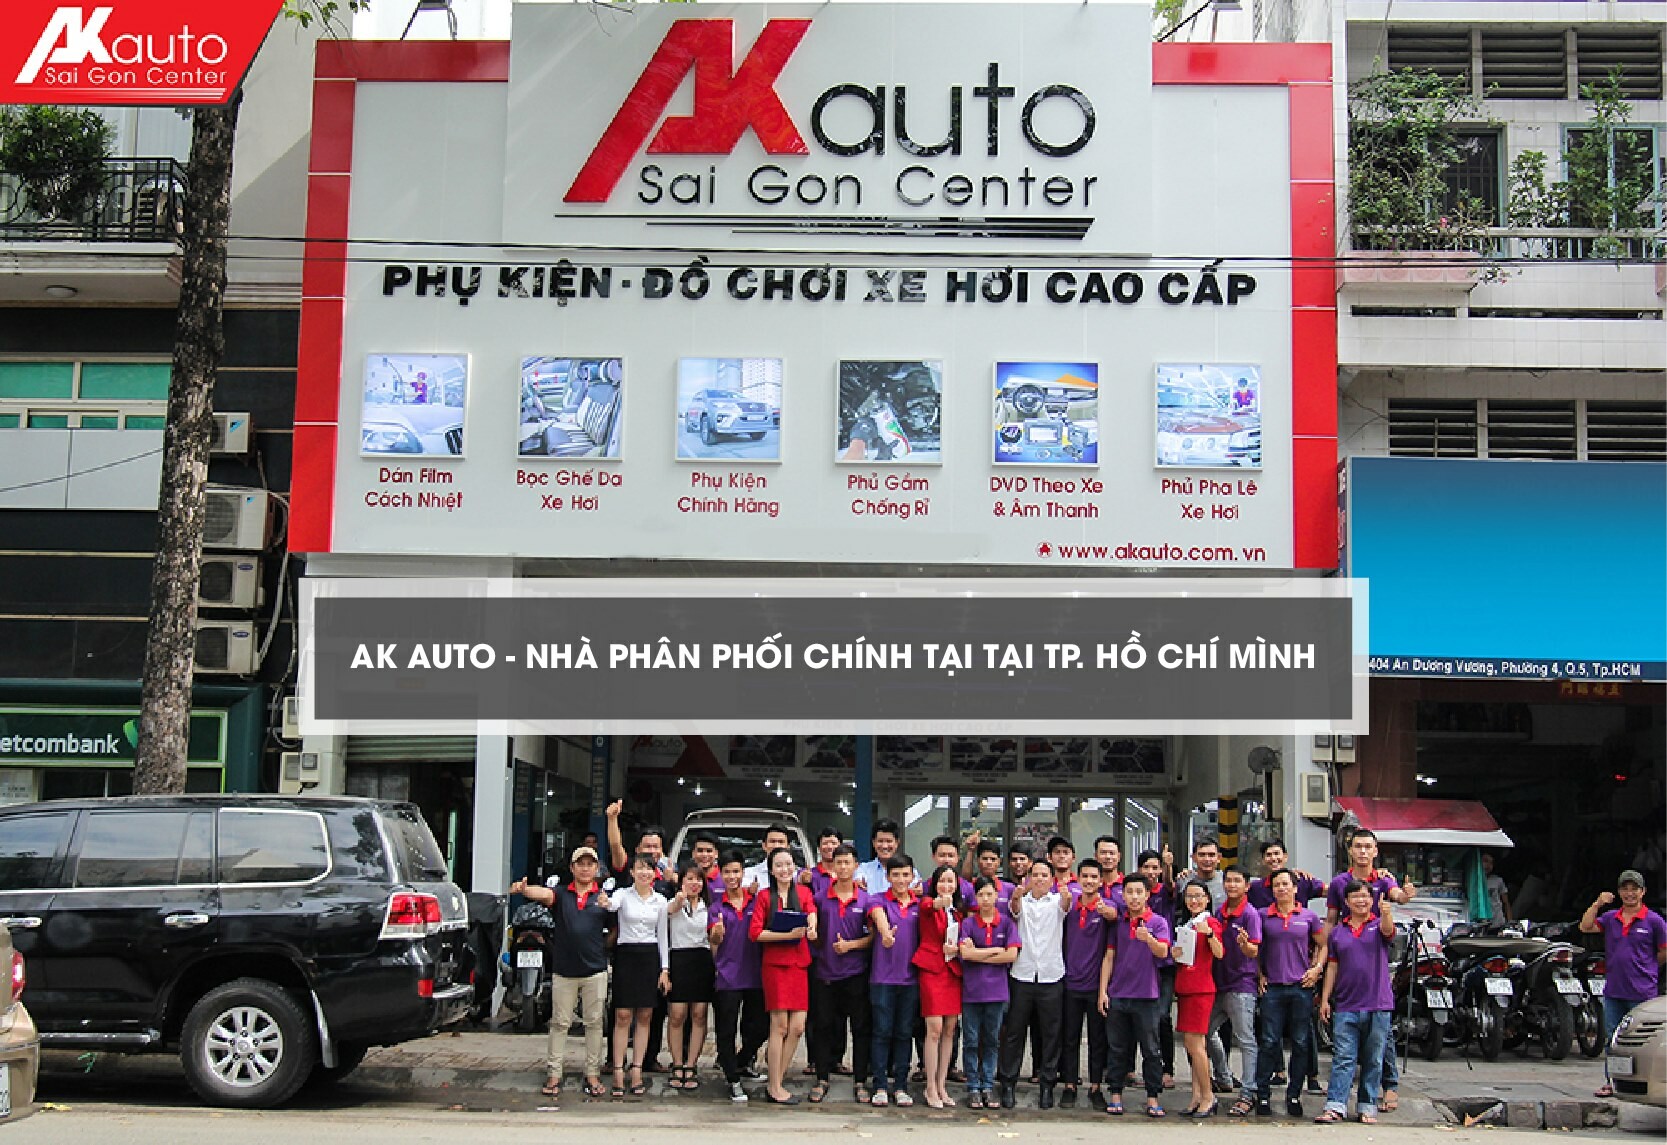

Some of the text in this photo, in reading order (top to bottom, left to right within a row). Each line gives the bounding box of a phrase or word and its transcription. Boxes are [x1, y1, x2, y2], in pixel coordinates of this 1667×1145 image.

[637, 164, 1098, 208] Sai Gon Center
[383, 264, 481, 306] PHỤ
[498, 257, 613, 307] KIỆN
[642, 254, 710, 299] ĐỒ
[727, 263, 848, 301] CHƠI
[863, 269, 928, 303] XE
[946, 265, 1029, 304] HƠI
[1046, 271, 1144, 305] CAO
[1158, 258, 1257, 306] CẤP
[379, 467, 453, 484] Dán Film
[516, 467, 623, 488] Bọc Ghế Da
[691, 472, 767, 492] Phụ Kiện
[847, 472, 879, 491] Phủ
[990, 476, 1104, 493] DVD Theo Xe
[1161, 476, 1258, 496] Phủ Pha Lê
[365, 490, 464, 513] Cách Nhiệt
[541, 493, 599, 511] Xe Hơi
[677, 496, 728, 513] Chính
[851, 497, 911, 520] Chống
[993, 498, 1099, 518] & Âm Thanh
[1181, 503, 1239, 519] Xe Hơi
[1369, 658, 1389, 670] 404
[1393, 658, 1409, 670] An
